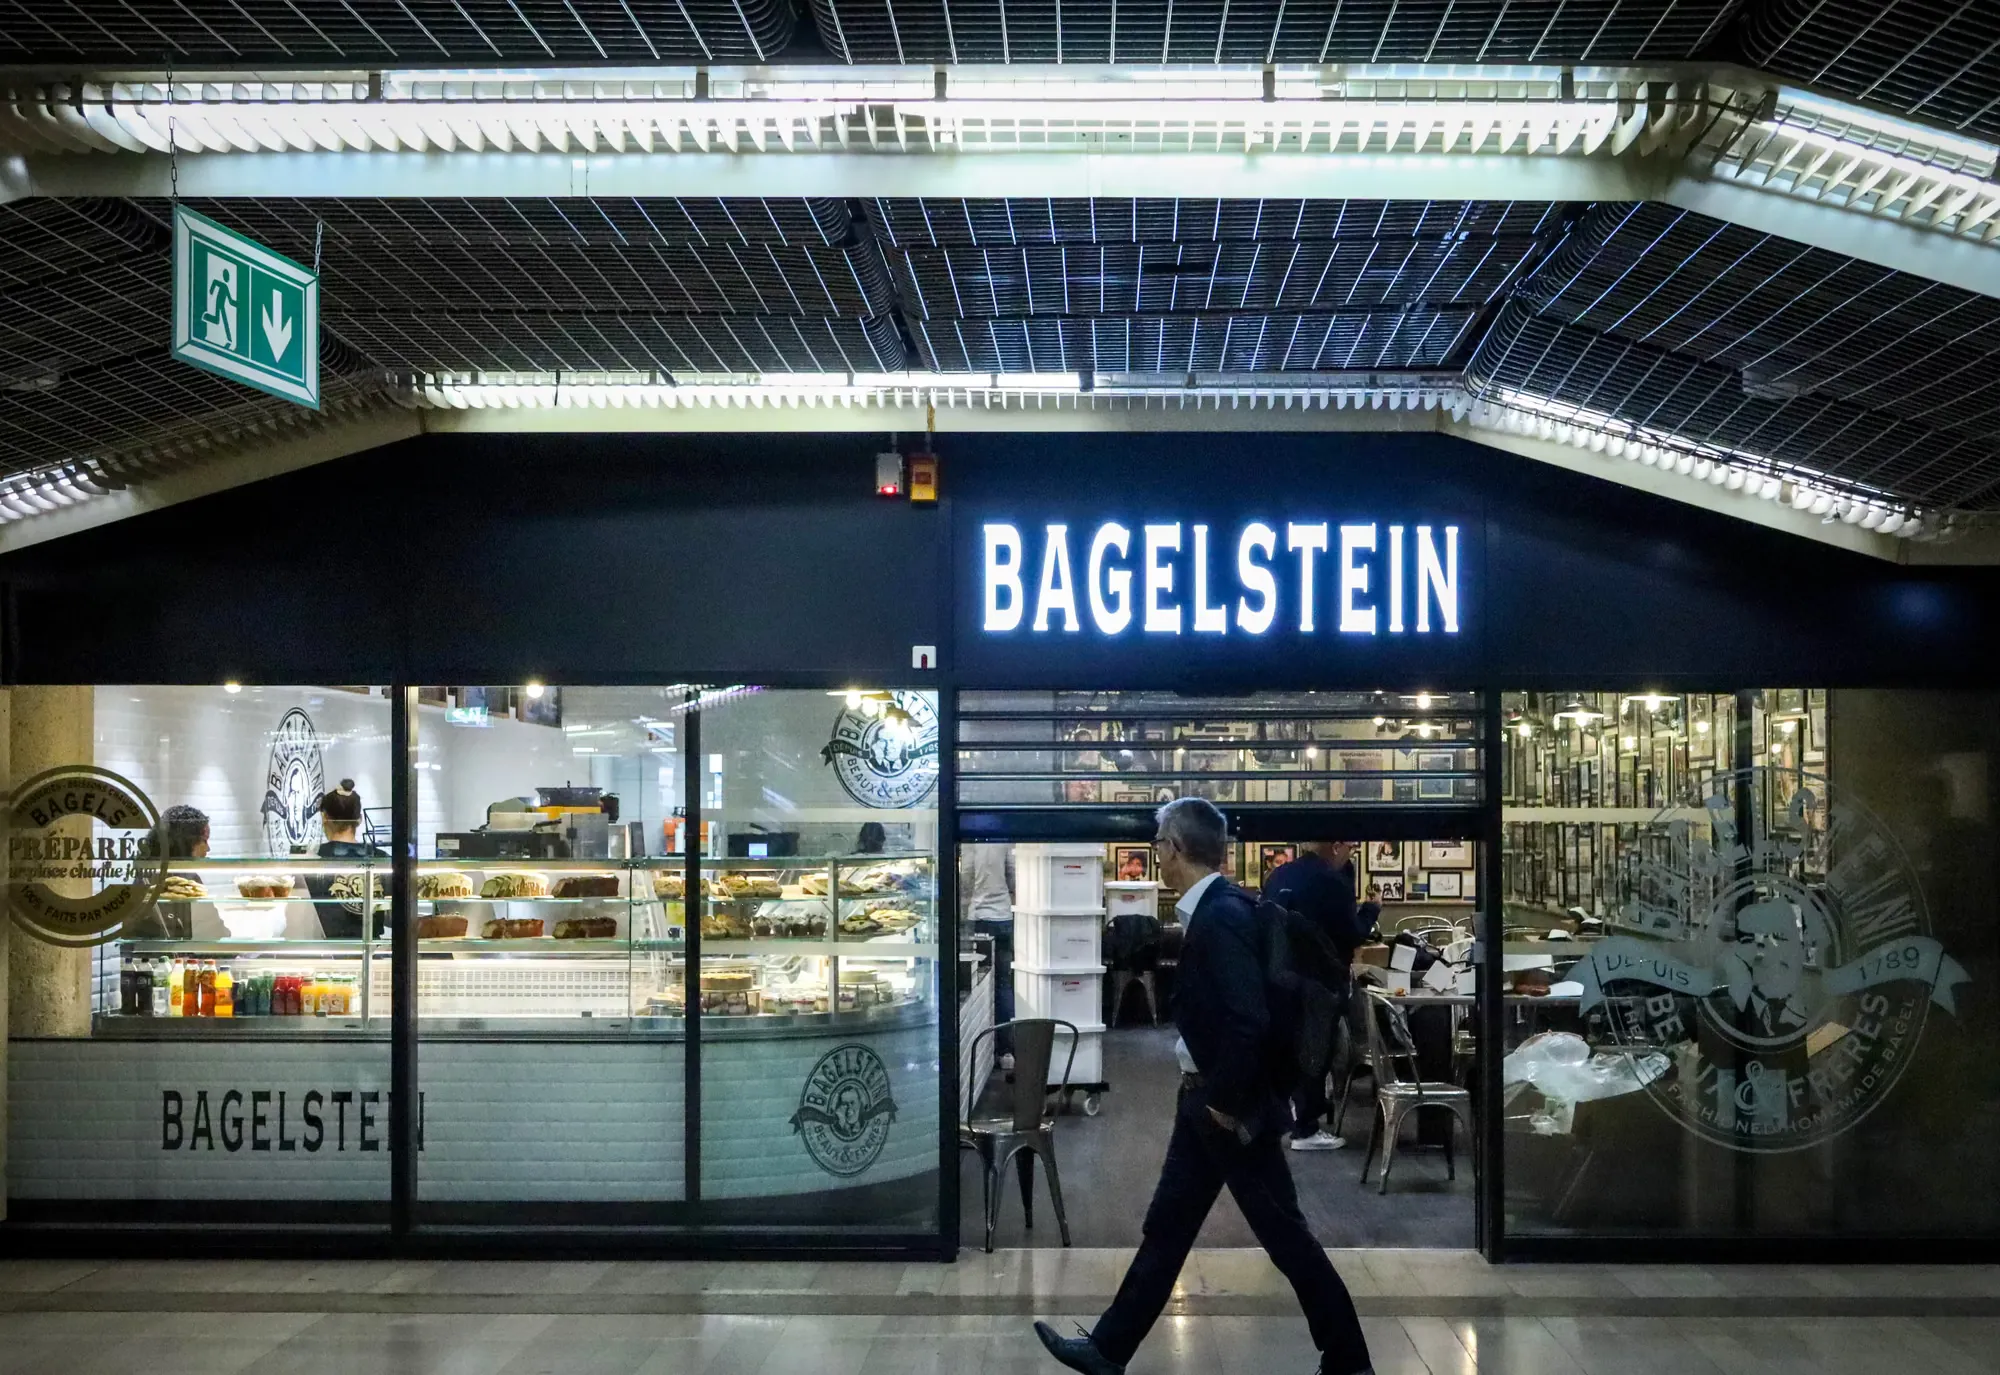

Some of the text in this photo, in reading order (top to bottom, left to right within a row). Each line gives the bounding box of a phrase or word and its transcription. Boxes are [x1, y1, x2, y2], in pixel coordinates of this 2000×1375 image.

[983, 521, 1459, 635] BAGELSTEIN
[839, 690, 938, 741] BASTEIN
[847, 758, 877, 795] BEAUX
[30, 792, 127, 827] BAGELS
[9, 831, 152, 860] PRÉPARÉS
[70, 862, 123, 882] chaque
[44, 906, 77, 924] FAITS
[79, 906, 102, 924] PAR
[1860, 946, 1919, 980] 1789
[1882, 998, 1916, 1063] BAGEL
[807, 1050, 888, 1105] BAGELSTEIN
[162, 1089, 425, 1152] BAGELSTE
[814, 1125, 840, 1162] BEAUX
